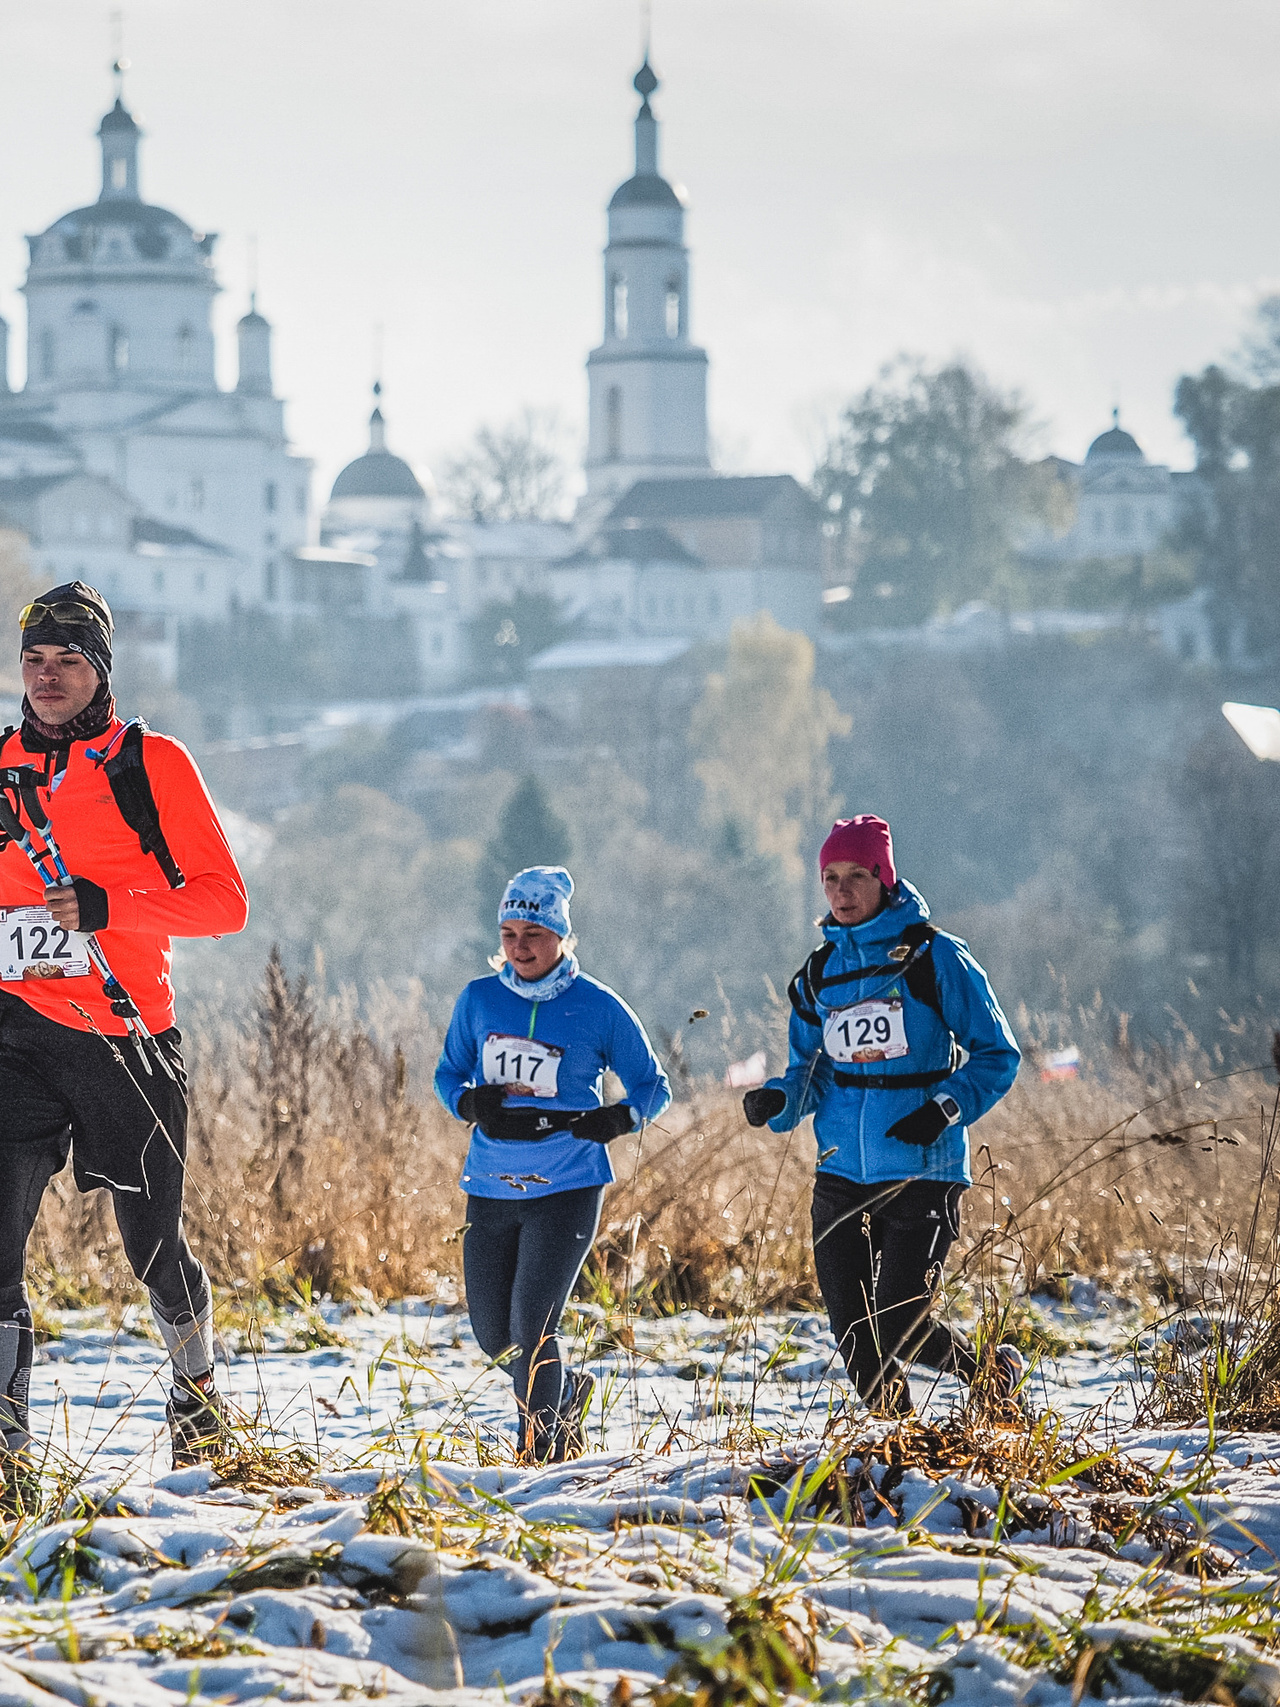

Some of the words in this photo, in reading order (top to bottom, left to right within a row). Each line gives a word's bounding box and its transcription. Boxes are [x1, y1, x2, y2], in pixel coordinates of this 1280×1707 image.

[10, 926, 72, 960] 122
[837, 1016, 891, 1047] 129
[495, 1051, 544, 1082] 117
